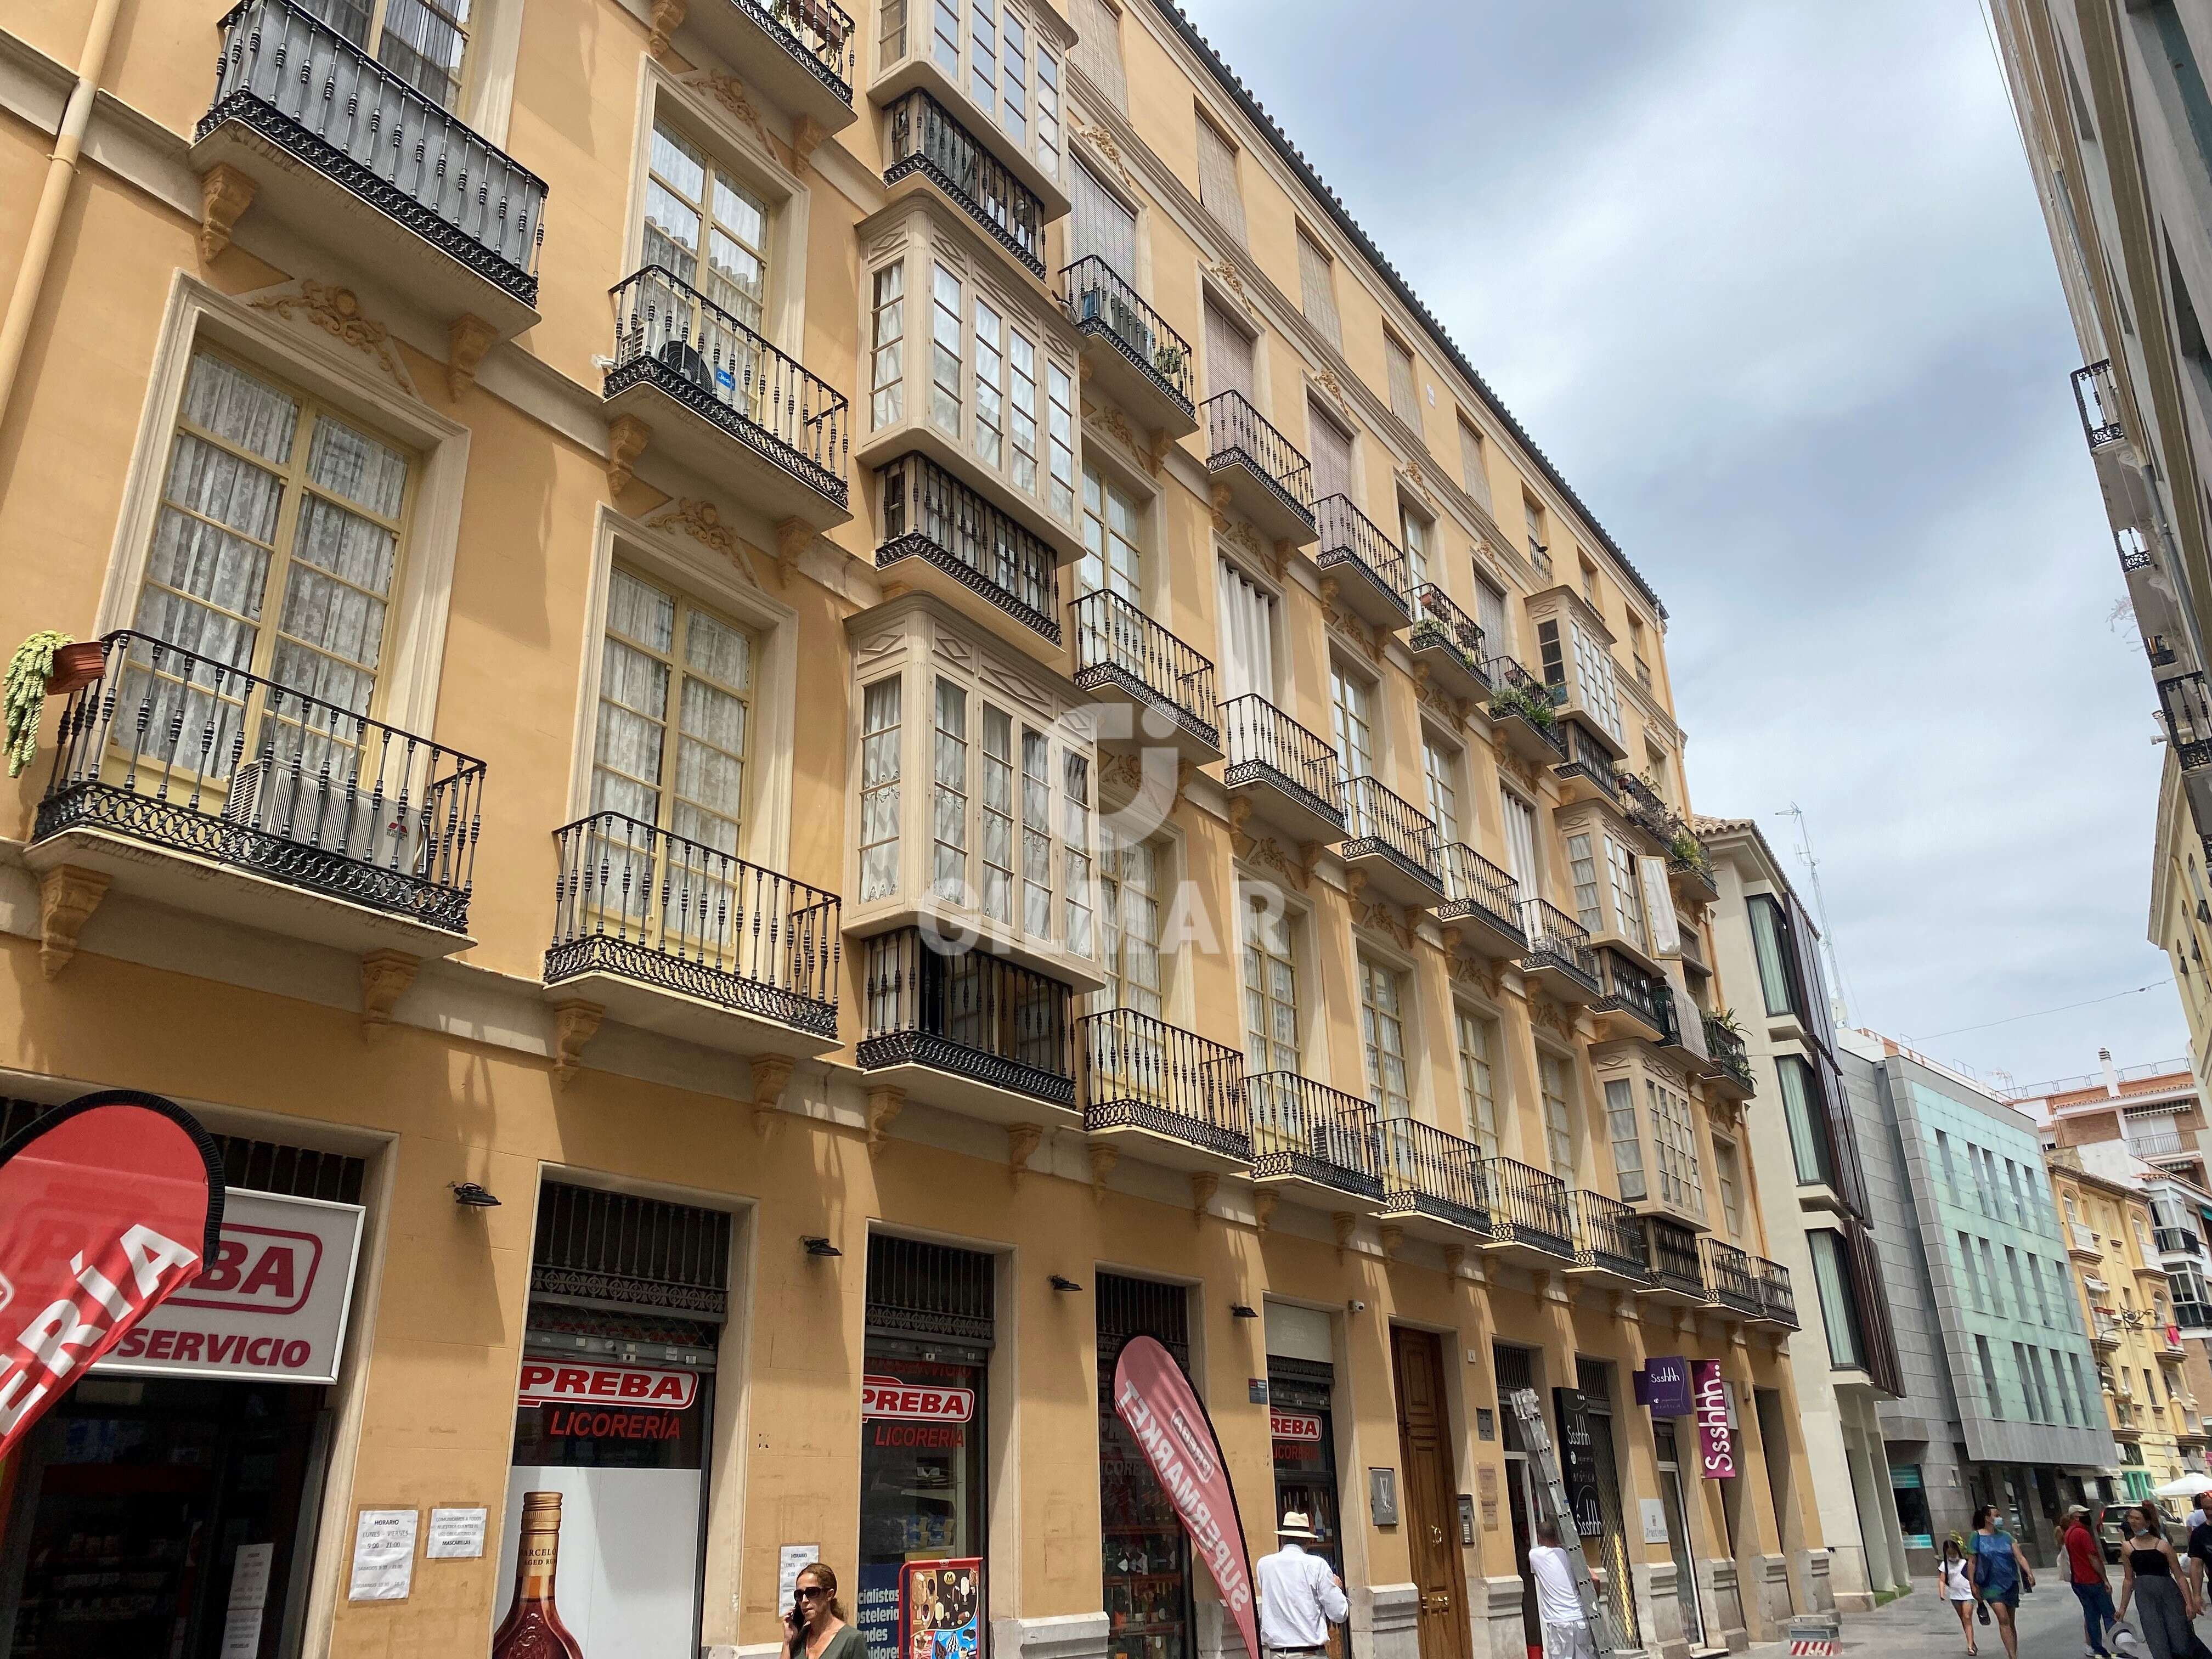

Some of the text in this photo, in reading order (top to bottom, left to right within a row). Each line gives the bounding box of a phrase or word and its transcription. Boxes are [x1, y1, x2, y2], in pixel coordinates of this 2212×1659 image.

[105, 1328, 311, 1368] SERVICIO
[519, 1365, 684, 1401] PREBA
[1651, 1367, 1680, 1383] Ssshhh
[550, 1410, 681, 1440] LICORERÍA
[874, 1425, 964, 1448] LICORERÍA
